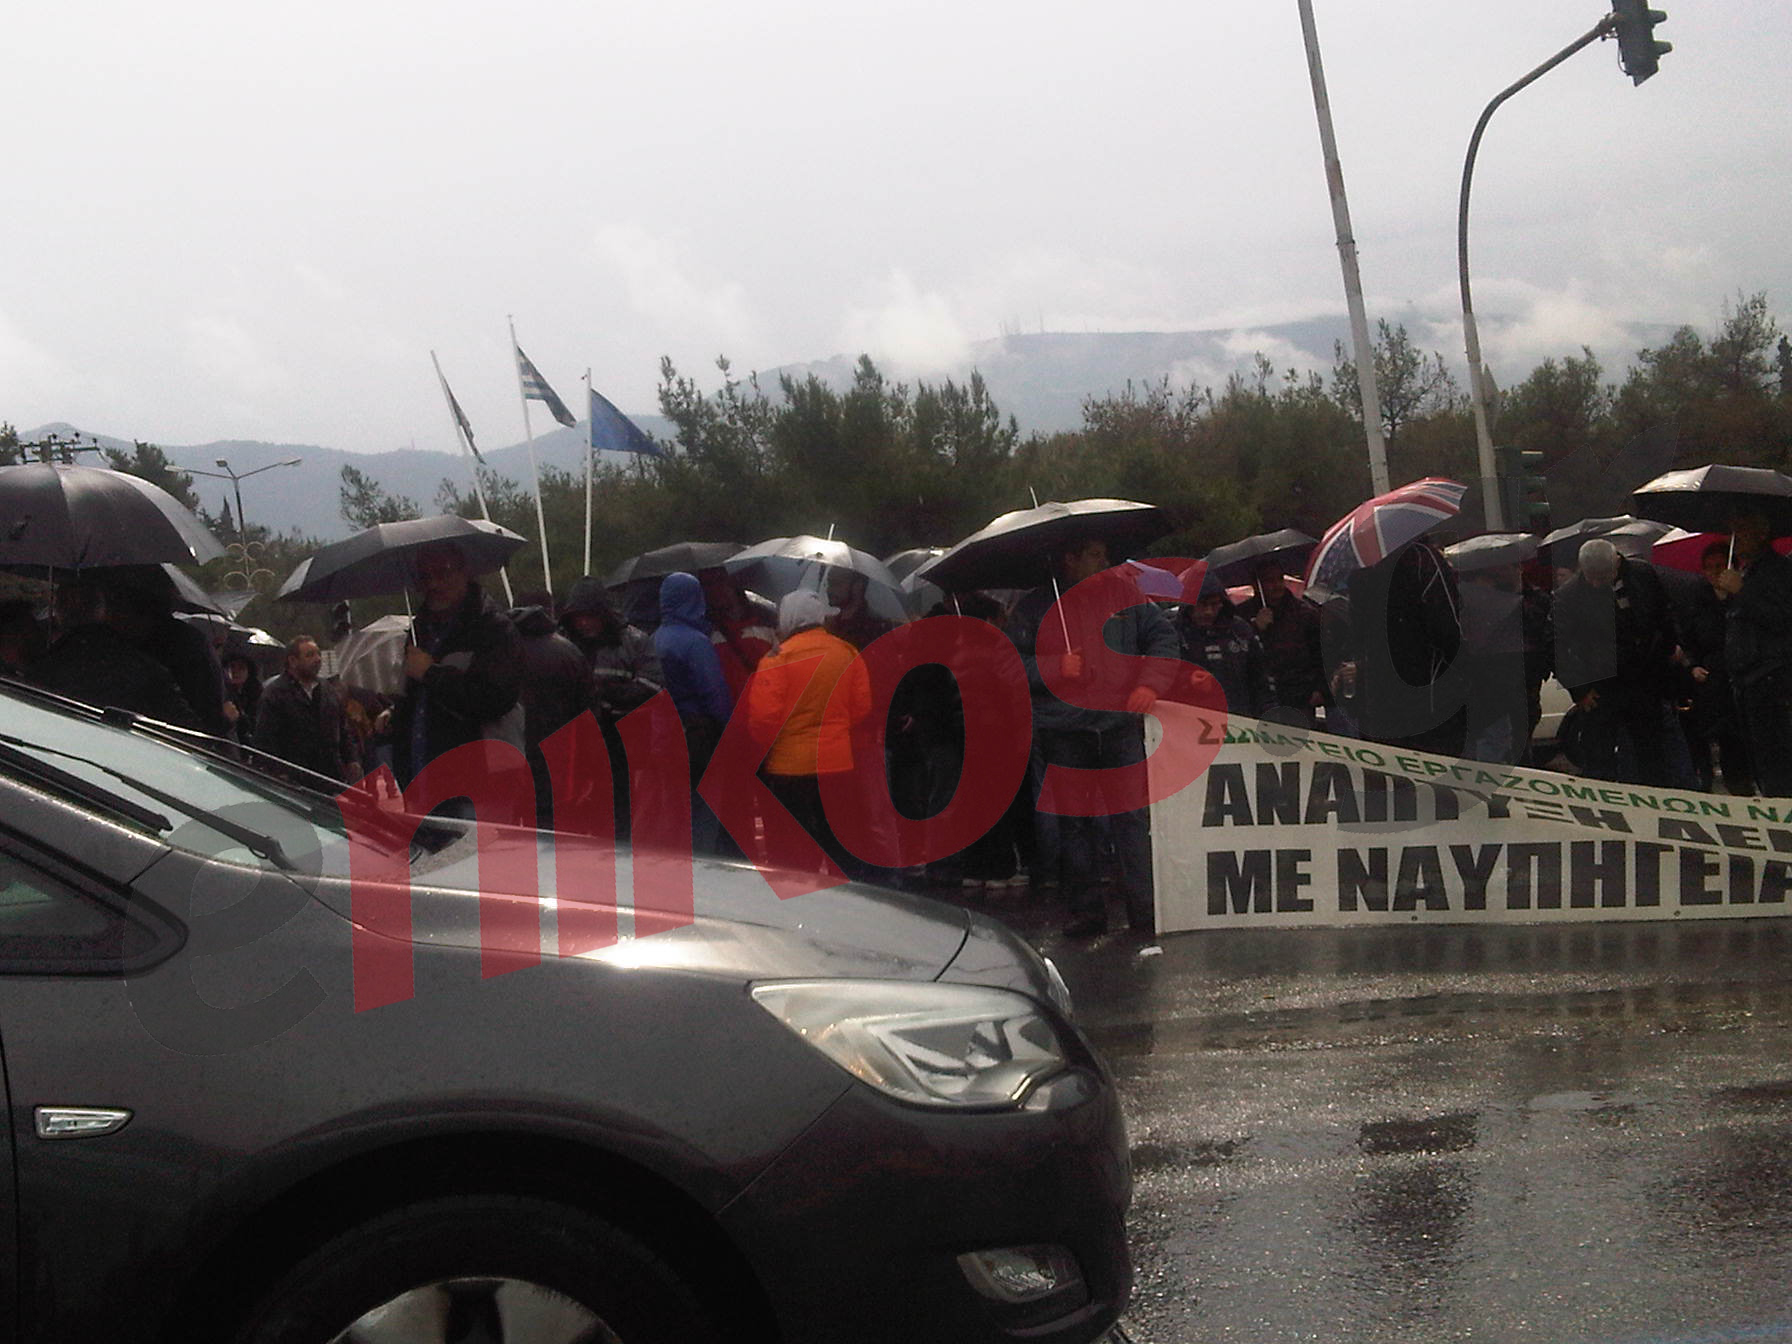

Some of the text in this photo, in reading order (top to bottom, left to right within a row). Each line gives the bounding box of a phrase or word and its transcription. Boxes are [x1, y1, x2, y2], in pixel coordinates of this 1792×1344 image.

[1202, 761, 1636, 836] ΑΝΑΠΤΥΞΗ
[1395, 754, 1731, 818] ΕΡΓΑΖΟΜΕΝΩΝ
[1207, 849, 1314, 915] ΜΕ
